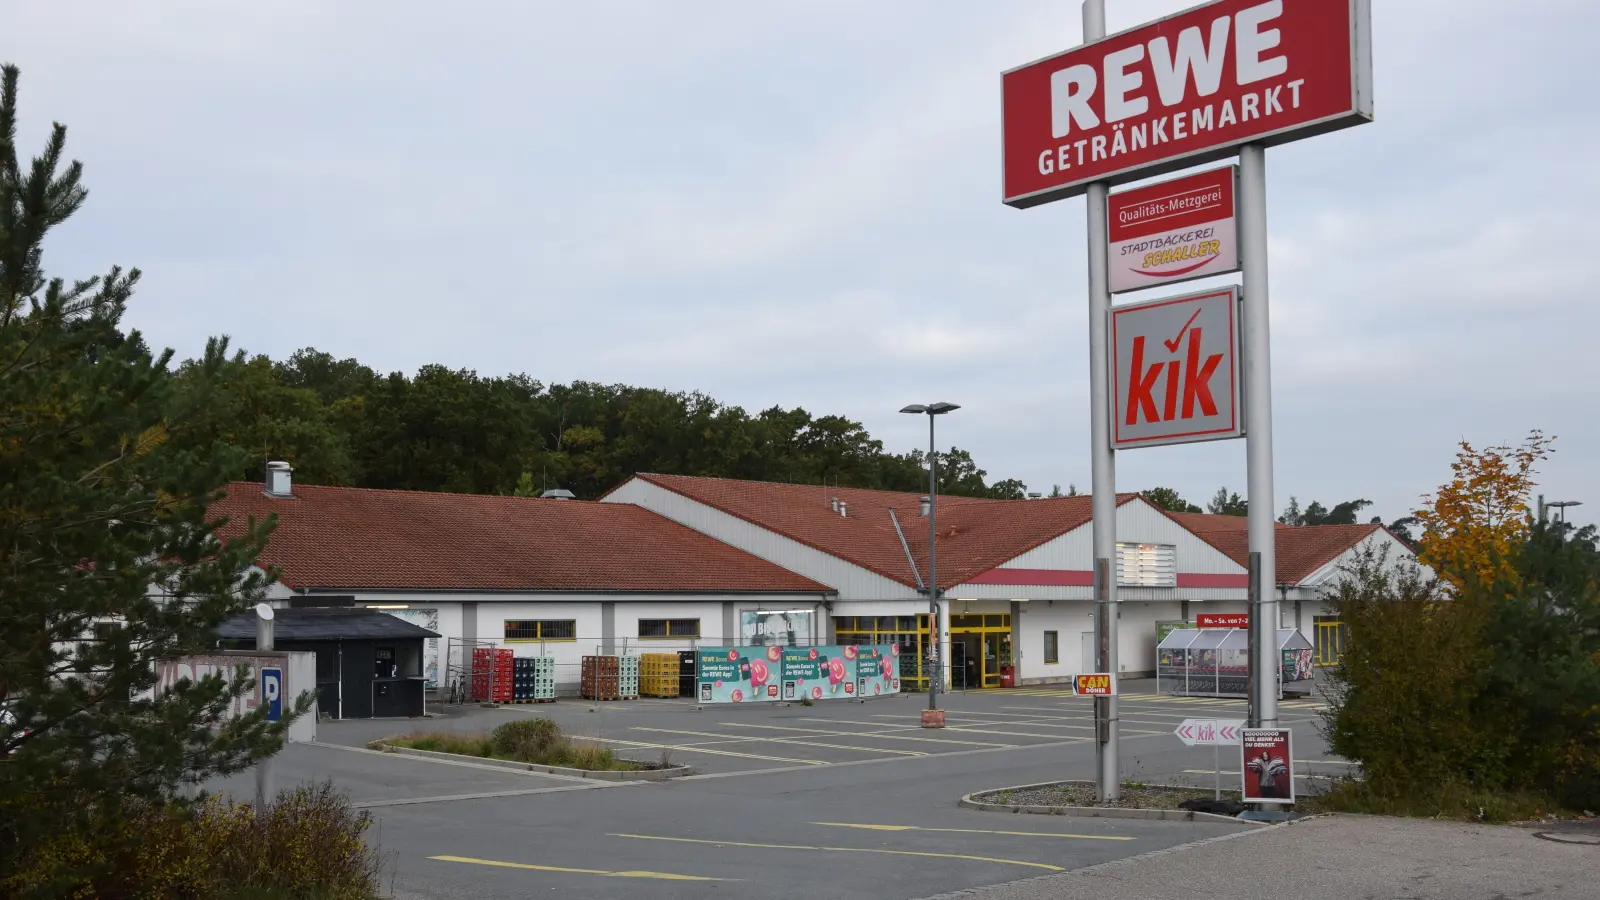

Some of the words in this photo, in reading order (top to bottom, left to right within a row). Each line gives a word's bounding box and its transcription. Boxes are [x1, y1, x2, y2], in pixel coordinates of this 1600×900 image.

[1050, 0, 1288, 139] REWE
[1038, 78, 1305, 175] GETRÄNKEMARKT
[1119, 188, 1222, 223] Qualitäts-Metzgerei
[1142, 239, 1221, 268] SCHALLER
[265, 675, 279, 714] P
[1078, 675, 1109, 688] CAN
[1085, 686, 1106, 694] DÖNER
